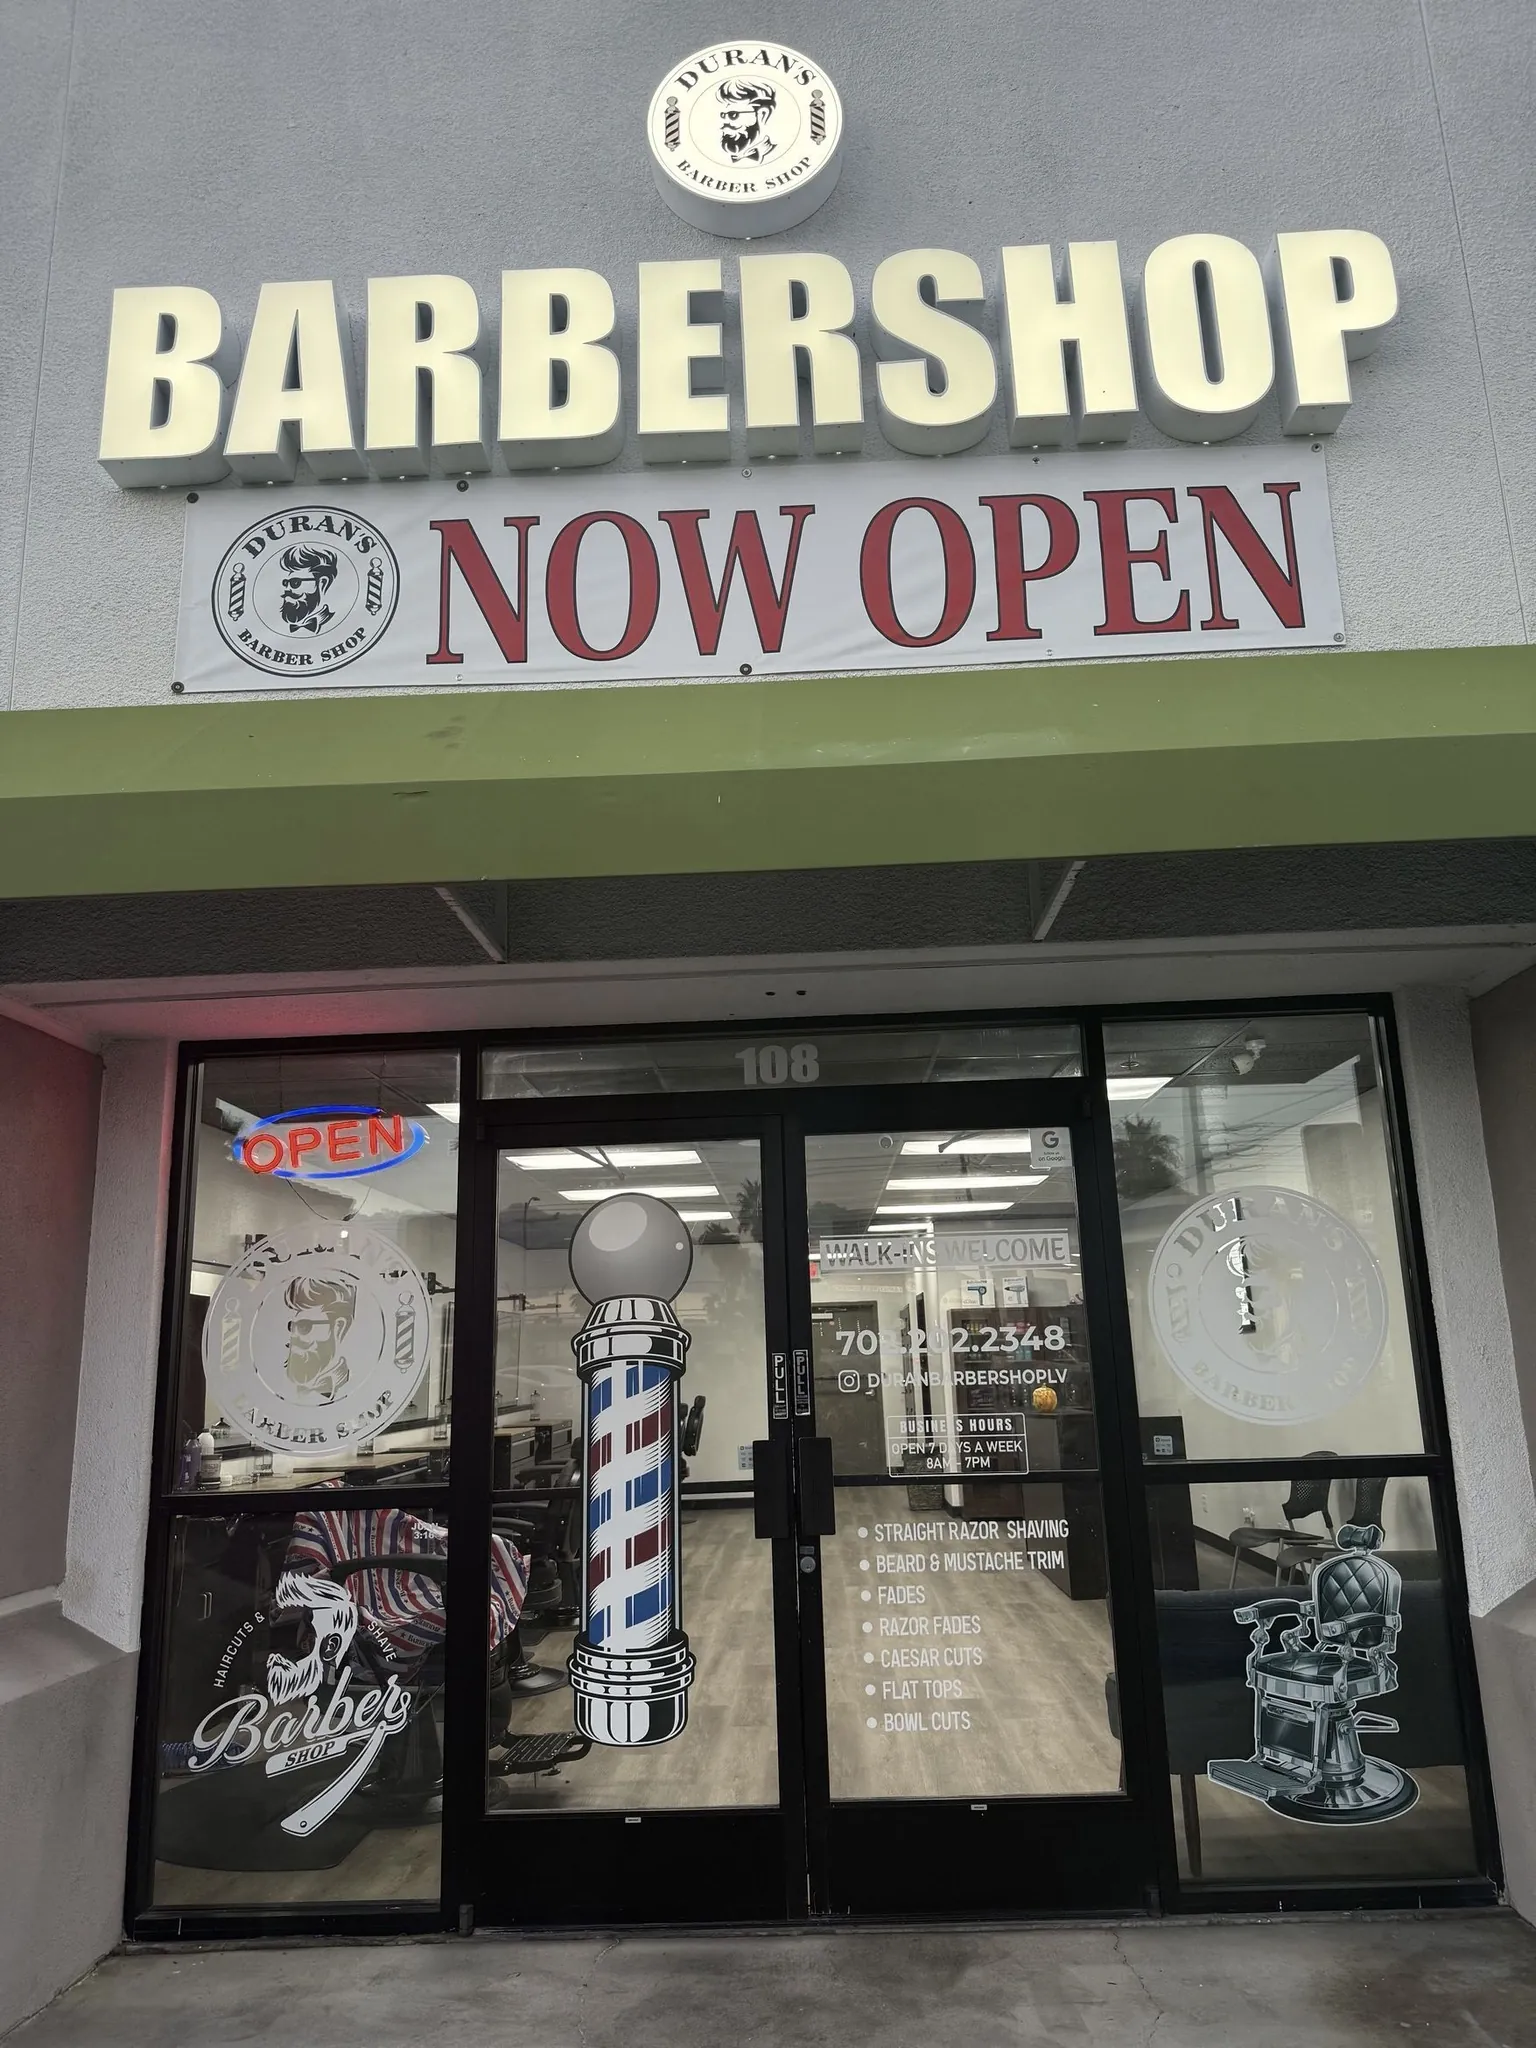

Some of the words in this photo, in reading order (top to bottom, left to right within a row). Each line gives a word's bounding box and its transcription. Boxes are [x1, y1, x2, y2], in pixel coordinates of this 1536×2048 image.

[674, 49, 817, 92] DURAN'S
[676, 160, 758, 194] BARBER
[765, 156, 812, 190] SHOP
[98, 229, 1398, 461] BARBERSHOP
[242, 515, 377, 559] DURAN'S
[426, 504, 816, 665] NOW
[859, 482, 1306, 648] OPEN
[237, 628, 314, 666] BARBER
[320, 627, 367, 662] SHOP
[735, 1044, 819, 1085] 108
[243, 1114, 404, 1173] OPEN
[825, 1241, 937, 1267] WALK-INS
[944, 1237, 1065, 1263] WELCOME
[775, 1355, 785, 1403] PULL
[796, 1356, 806, 1394] PULL
[900, 1419, 963, 1433] BUSINES
[970, 1418, 1012, 1432] HOURS
[892, 1442, 925, 1455] OPEN
[929, 1442, 935, 1454] 7
[974, 1441, 984, 1453] A
[987, 1440, 1023, 1453] WEEK
[965, 1456, 990, 1468] 7PM
[875, 1522, 945, 1542] STRAIGHT
[949, 1521, 1000, 1540] RAZOR
[1007, 1519, 1069, 1539] SHAVING
[876, 1554, 926, 1573] BEARD
[930, 1553, 940, 1571] &
[944, 1551, 1024, 1571] MUSTACHE
[1027, 1550, 1065, 1569] TRIM
[878, 1585, 926, 1605] FADES
[880, 1617, 929, 1636] RAZOR
[933, 1615, 981, 1635] FADES
[214, 1621, 254, 1688] HAIRCUTS
[254, 1612, 265, 1624] &
[367, 1621, 397, 1662] SHAVE
[881, 1649, 940, 1668] CAESAR
[944, 1647, 983, 1667] CUTS
[882, 1681, 918, 1700] FLAT
[923, 1679, 962, 1699] TOPS
[187, 1666, 412, 1772] Barber
[884, 1712, 928, 1732] BOWL
[931, 1711, 971, 1730] CUTS
[285, 1741, 336, 1768] SHOP
